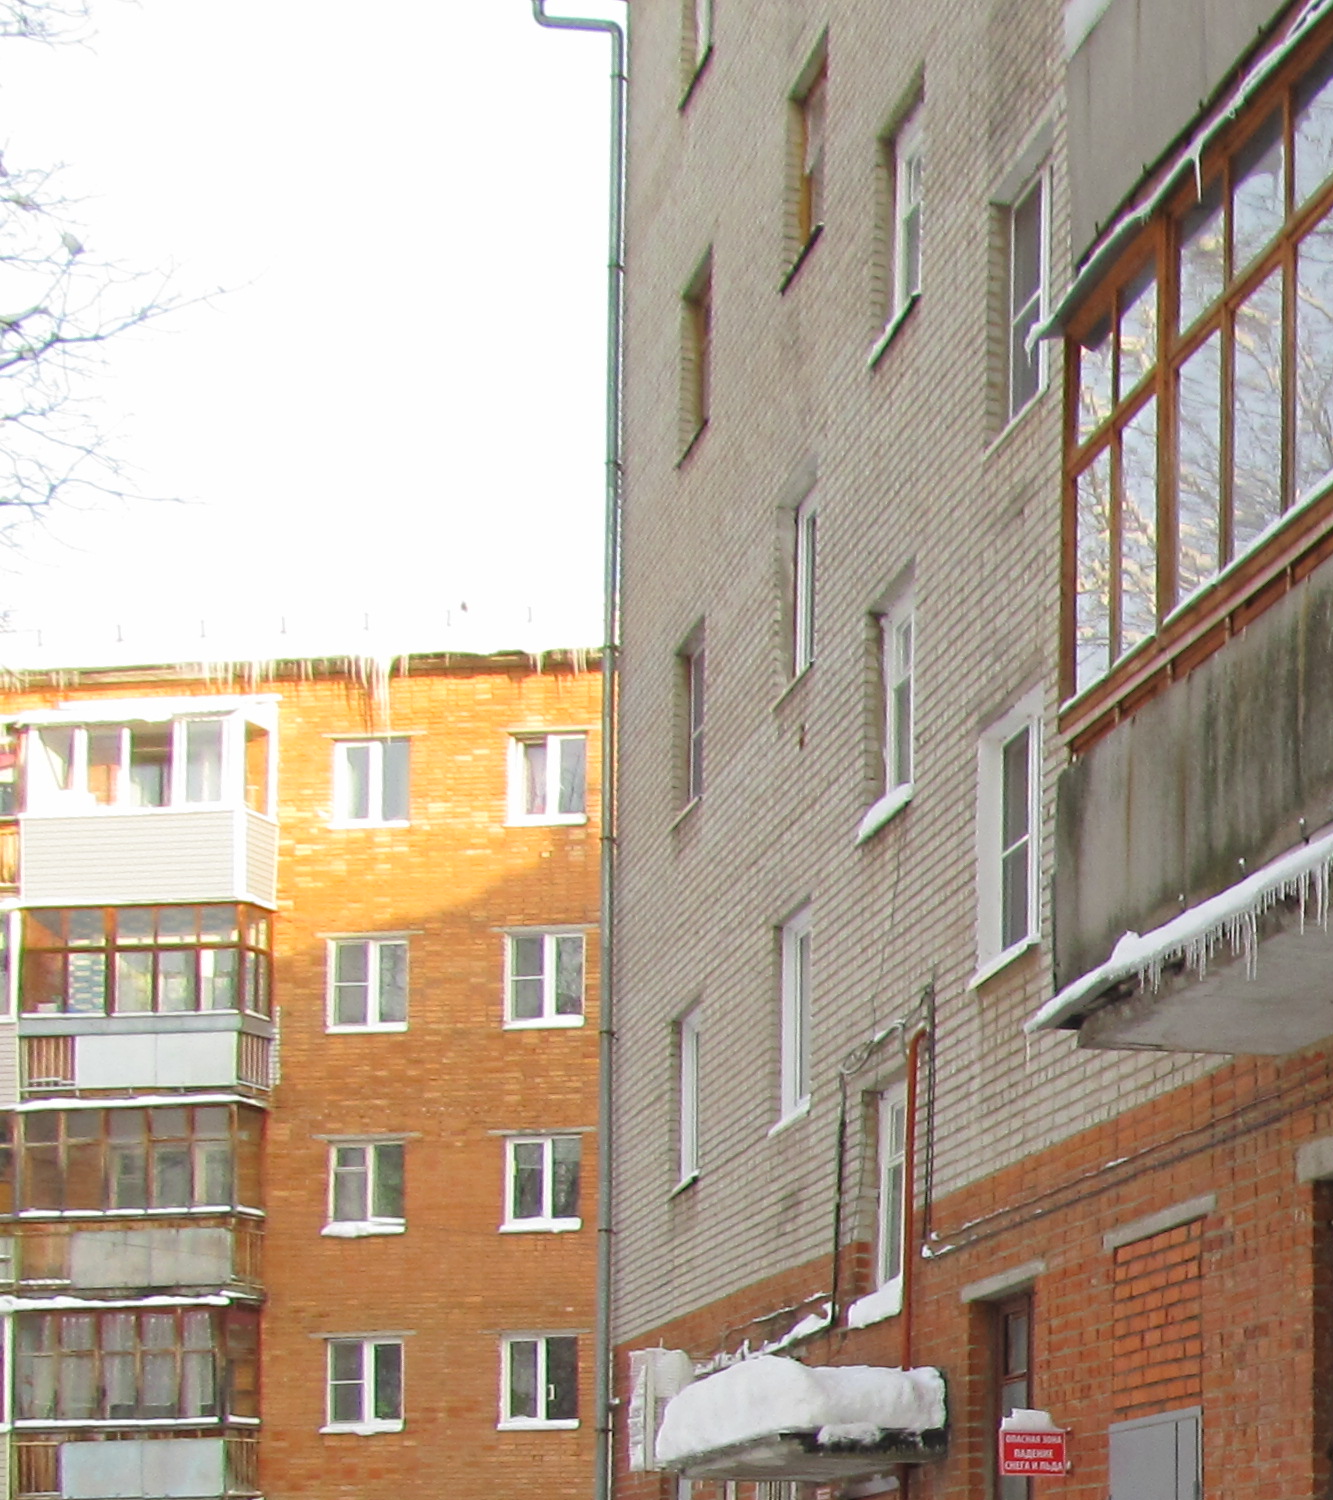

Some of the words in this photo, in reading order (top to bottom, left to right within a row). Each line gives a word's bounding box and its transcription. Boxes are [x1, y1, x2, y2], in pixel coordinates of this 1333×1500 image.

[1005, 1435, 1040, 1443] ОПАСНАЯ
[1041, 1435, 1062, 1443] ЗОНА
[1014, 1449, 1053, 1459] ПАДЕНИЕ
[1004, 1461, 1030, 1470] СНЕГА
[1031, 1461, 1039, 1470] И
[1040, 1461, 1063, 1471] ЛЬДА
